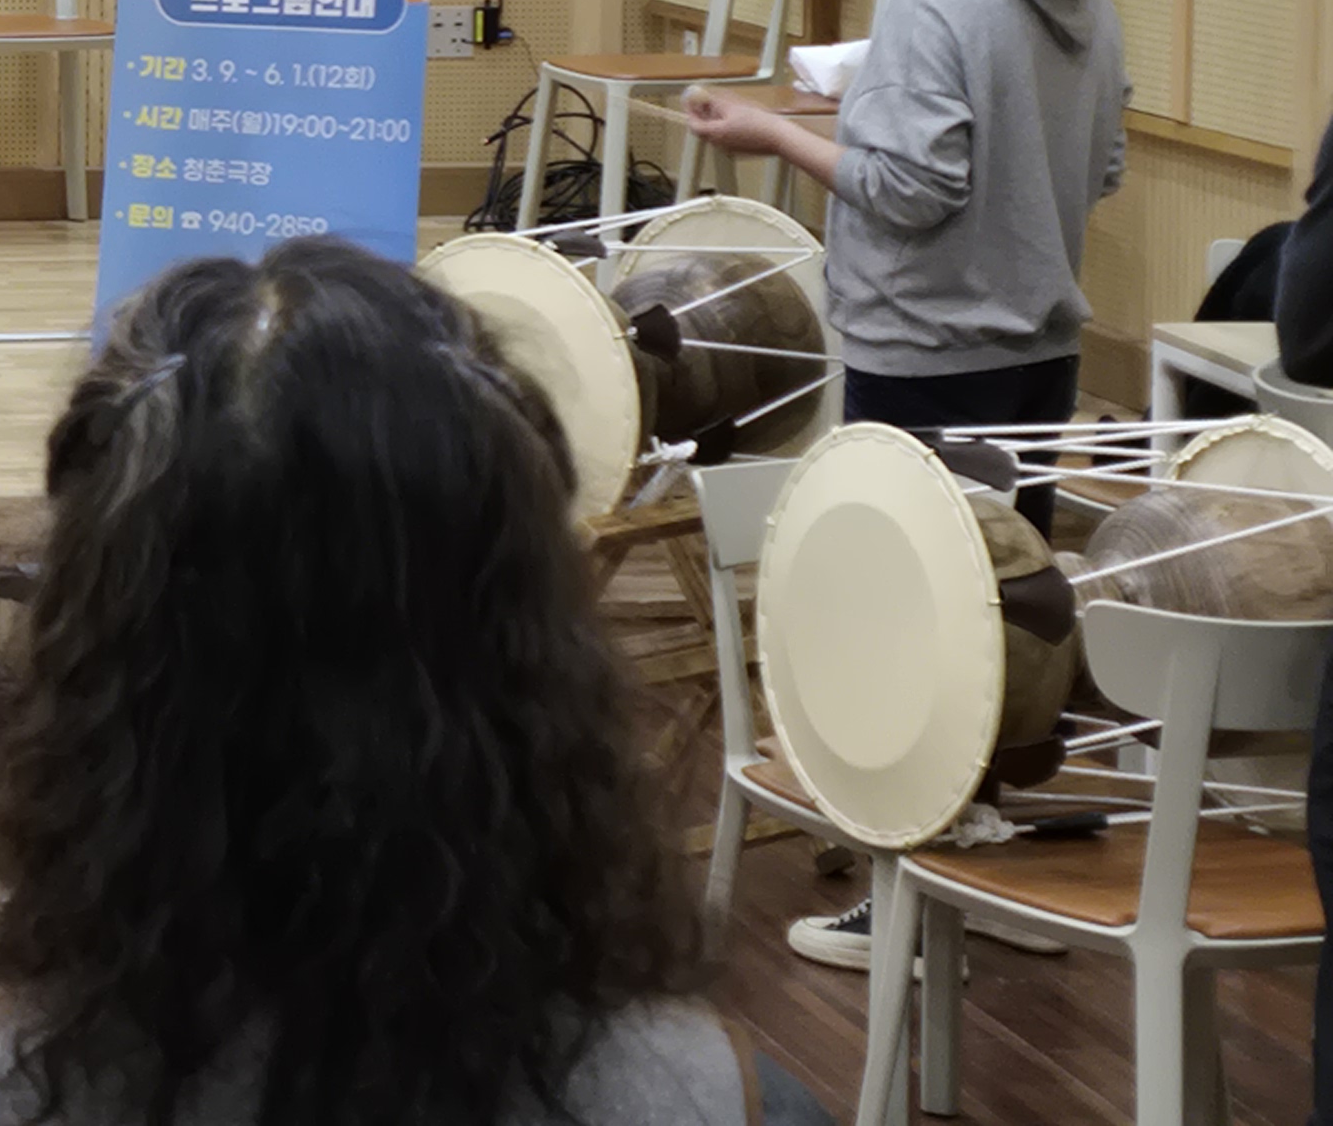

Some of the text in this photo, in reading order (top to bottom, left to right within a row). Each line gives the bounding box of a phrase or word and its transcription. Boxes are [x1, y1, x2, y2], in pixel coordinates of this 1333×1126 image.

[139, 55, 187, 81] 기간
[136, 106, 184, 130] 시간
[132, 155, 273, 185] 장소 청춘극장
[128, 204, 174, 229] 문의
